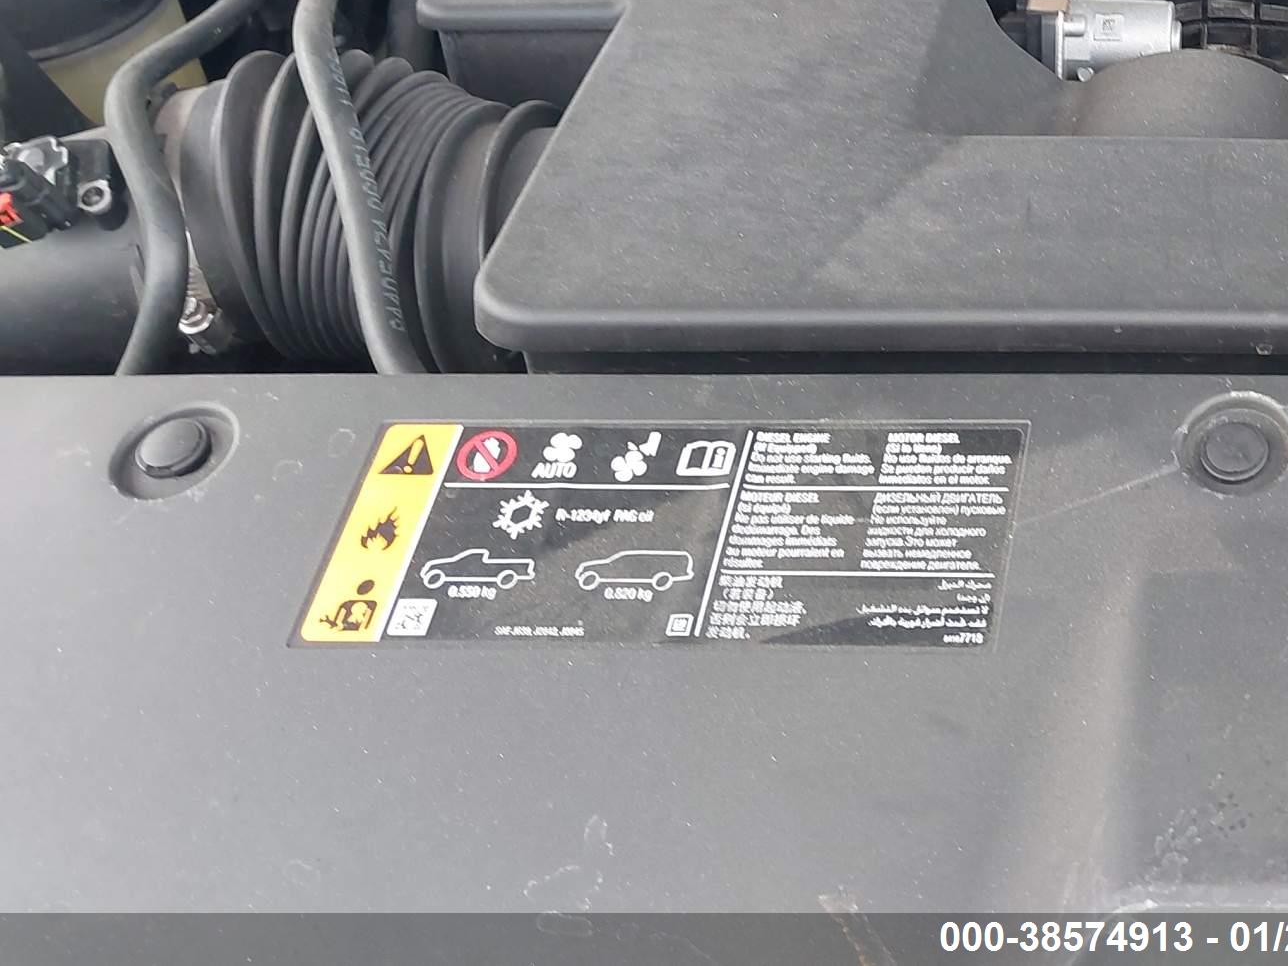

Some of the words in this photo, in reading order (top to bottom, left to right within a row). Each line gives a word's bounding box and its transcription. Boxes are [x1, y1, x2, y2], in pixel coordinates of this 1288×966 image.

[888, 433, 924, 443] MOTOR
[531, 462, 578, 478] AUTO
[481, 586, 497, 600] kg
[637, 587, 653, 602] kg
